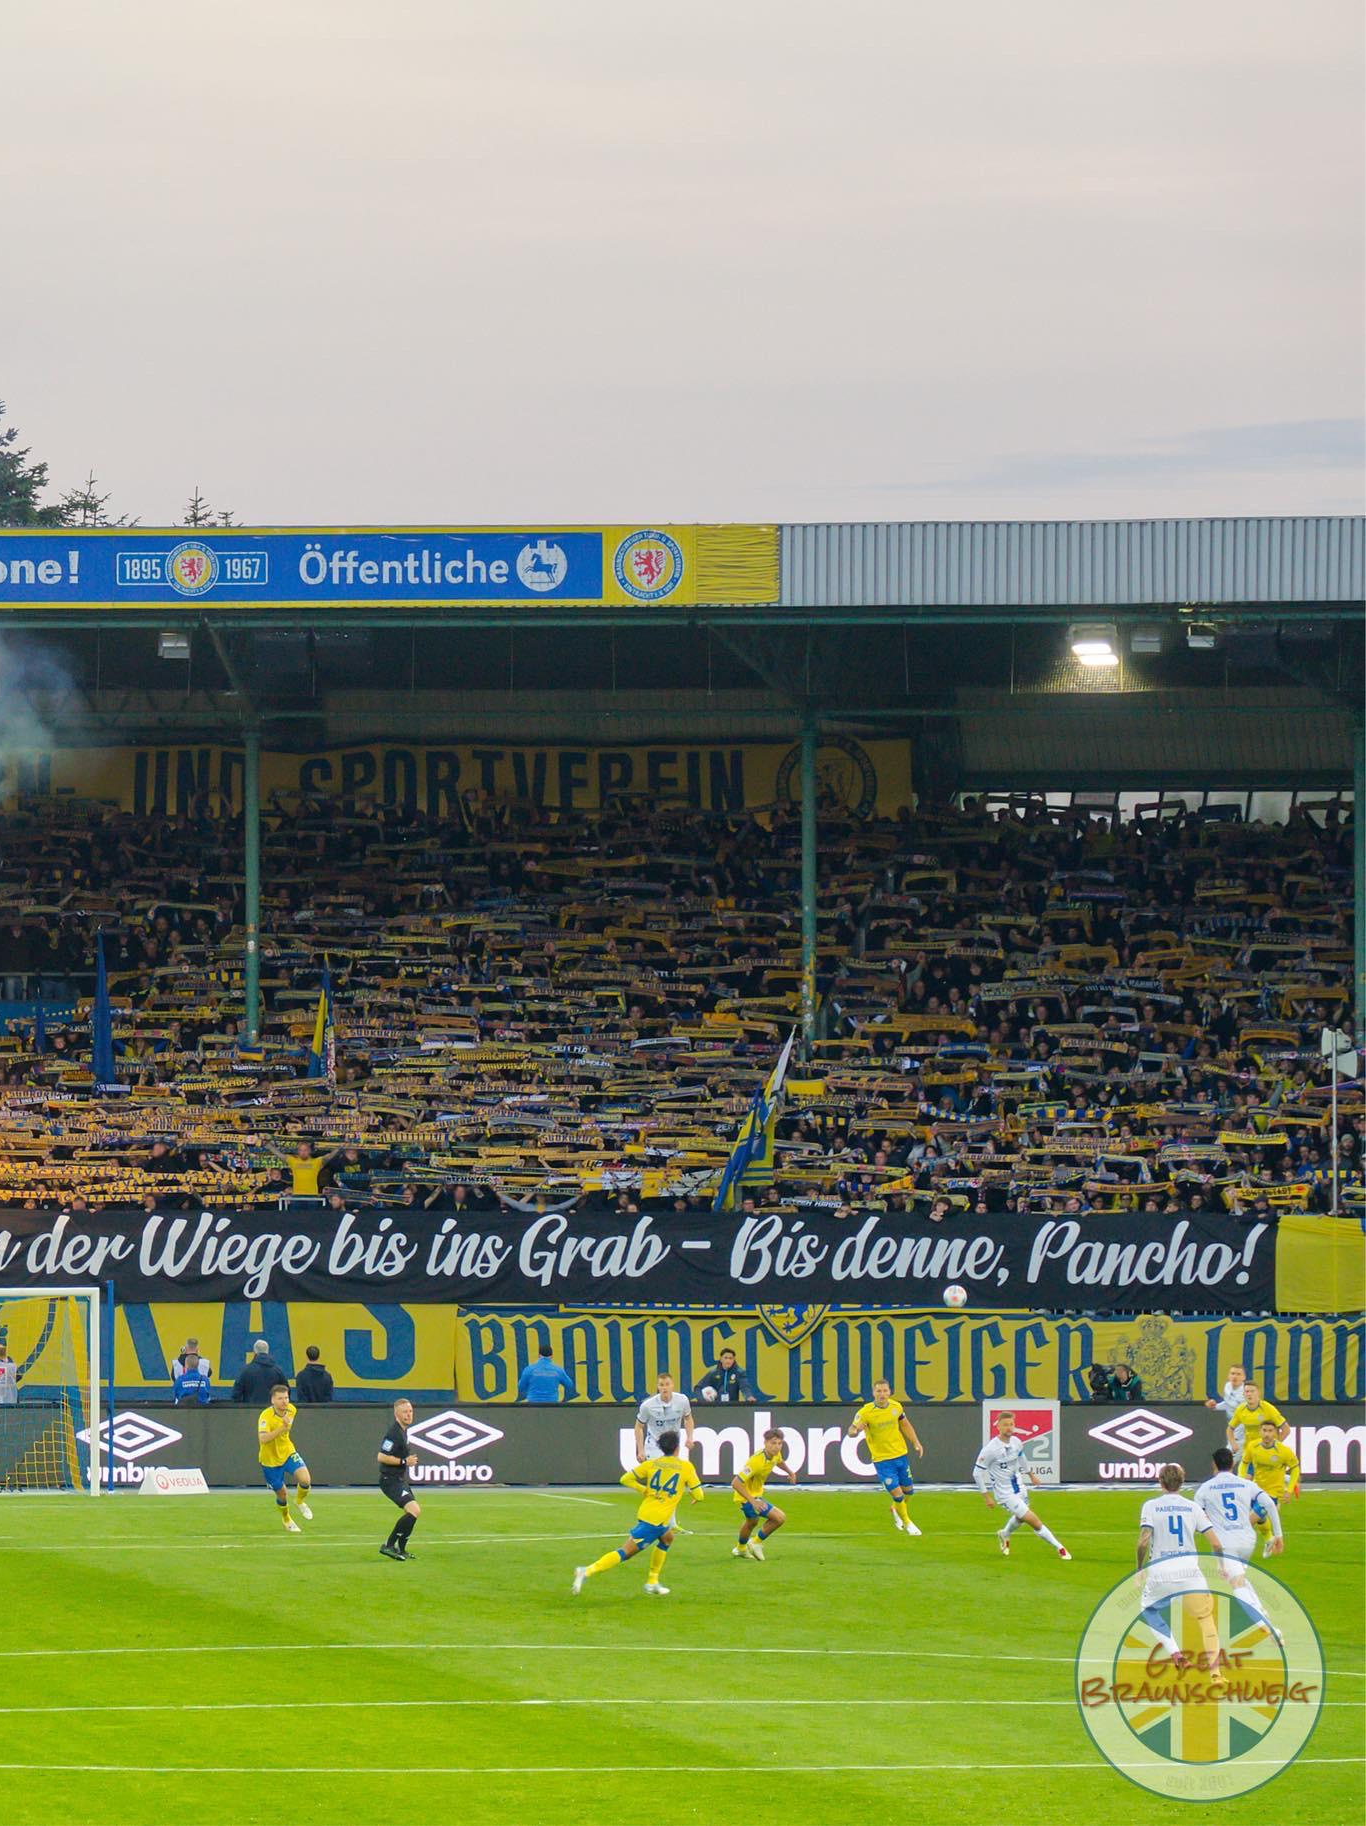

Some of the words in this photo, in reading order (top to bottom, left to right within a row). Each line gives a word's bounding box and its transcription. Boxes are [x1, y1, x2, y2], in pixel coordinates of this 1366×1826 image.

[124, 558, 161, 581] 1895
[225, 558, 261, 580] 1967
[298, 543, 509, 585] Öffentliche
[210, 1194, 270, 1204] ULTRAS
[27, 1214, 135, 1276] der
[139, 1212, 321, 1299] Wiege
[328, 1213, 418, 1277] bis
[426, 1217, 513, 1278] ins
[519, 1214, 672, 1286] Grab
[730, 1214, 829, 1285] Bis
[832, 1215, 1011, 1286] denne,
[1027, 1220, 1270, 1286] Pancho!
[464, 1316, 1094, 1404] BRAUNSCHWEIGER
[1032, 1437, 1050, 1459] 2
[170, 1477, 204, 1488] VEOLIA
[408, 1460, 493, 1482] umbro
[649, 1468, 681, 1497] 44
[1221, 1492, 1239, 1522] 5
[1167, 1514, 1184, 1547] 4
